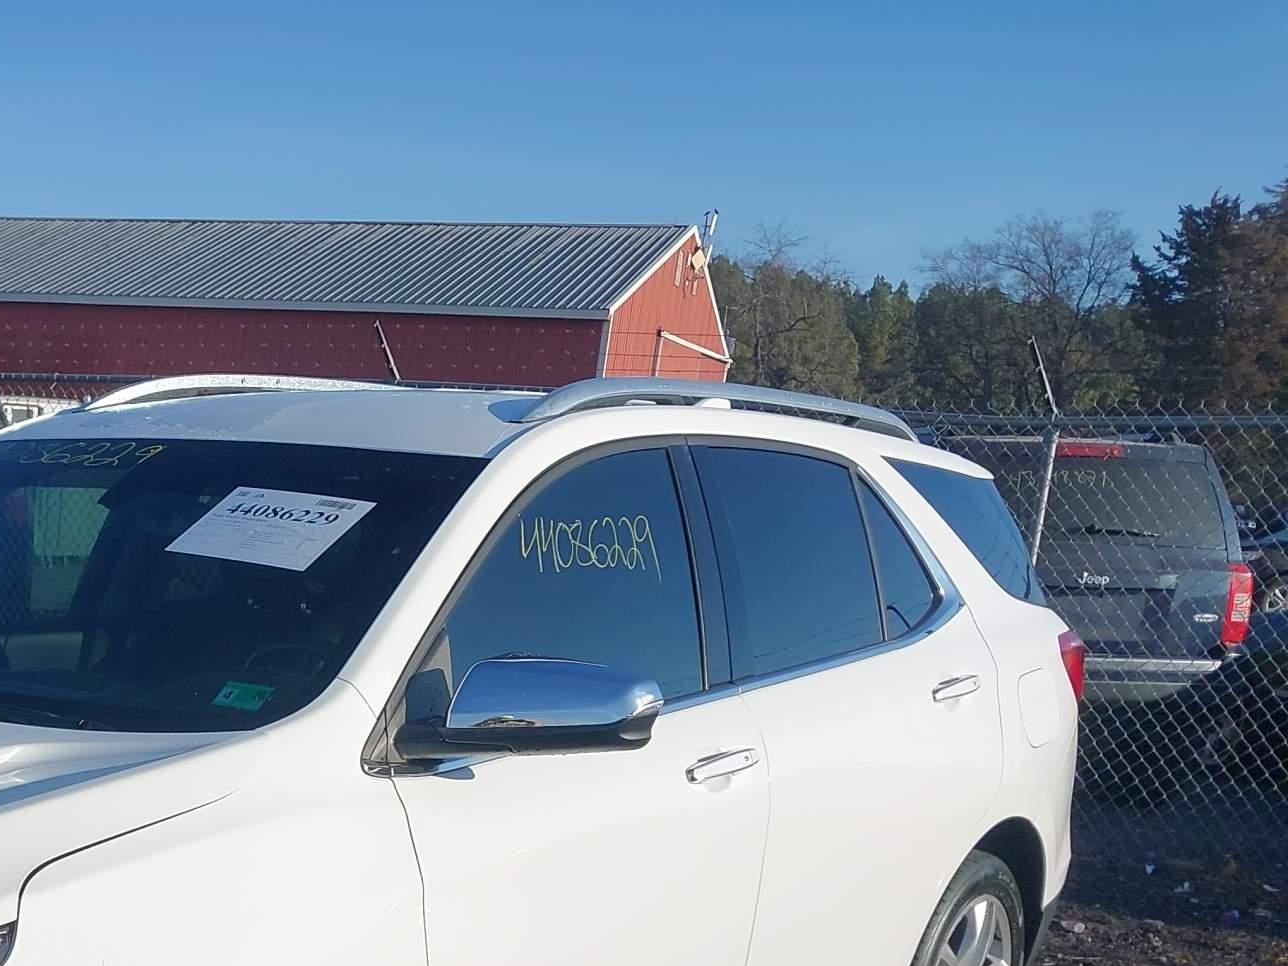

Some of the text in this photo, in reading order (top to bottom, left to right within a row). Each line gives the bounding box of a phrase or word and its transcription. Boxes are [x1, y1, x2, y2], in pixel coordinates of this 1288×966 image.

[226, 502, 340, 526] 44086229
[518, 514, 662, 583] 44086229
[1078, 570, 1111, 586] Jeep
